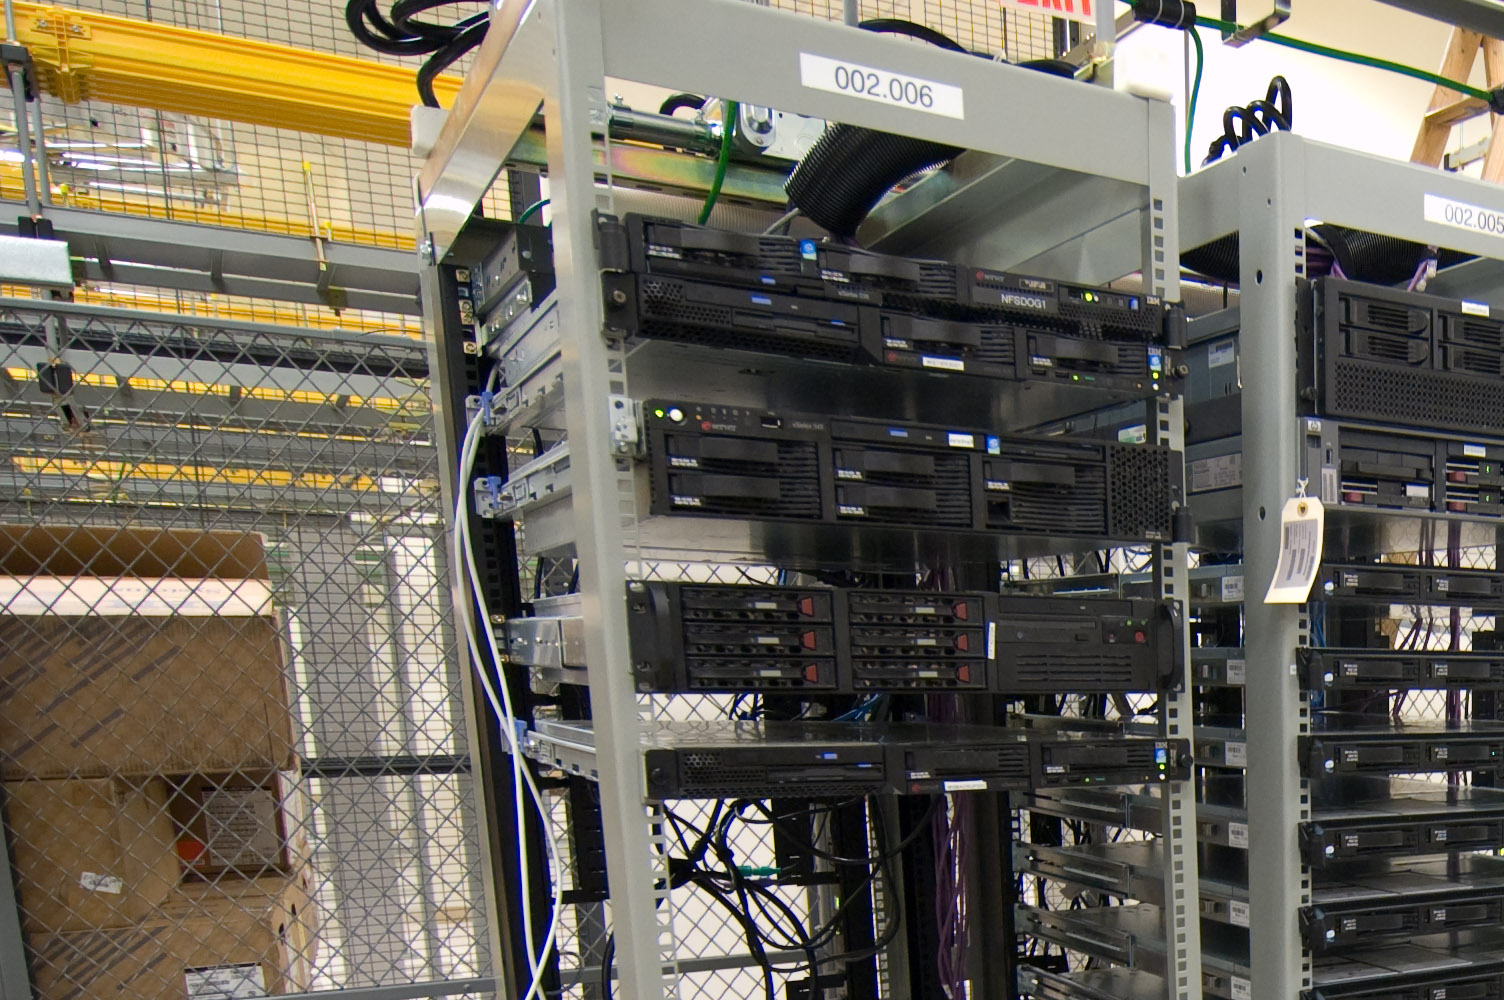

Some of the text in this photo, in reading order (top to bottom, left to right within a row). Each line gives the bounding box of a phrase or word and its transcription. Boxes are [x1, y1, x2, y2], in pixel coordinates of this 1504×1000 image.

[835, 66, 933, 108] 002.006
[1445, 204, 1504, 234] 002.005
[1000, 293, 1047, 310] NFSDOG1
[1146, 295, 1161, 306] IBM
